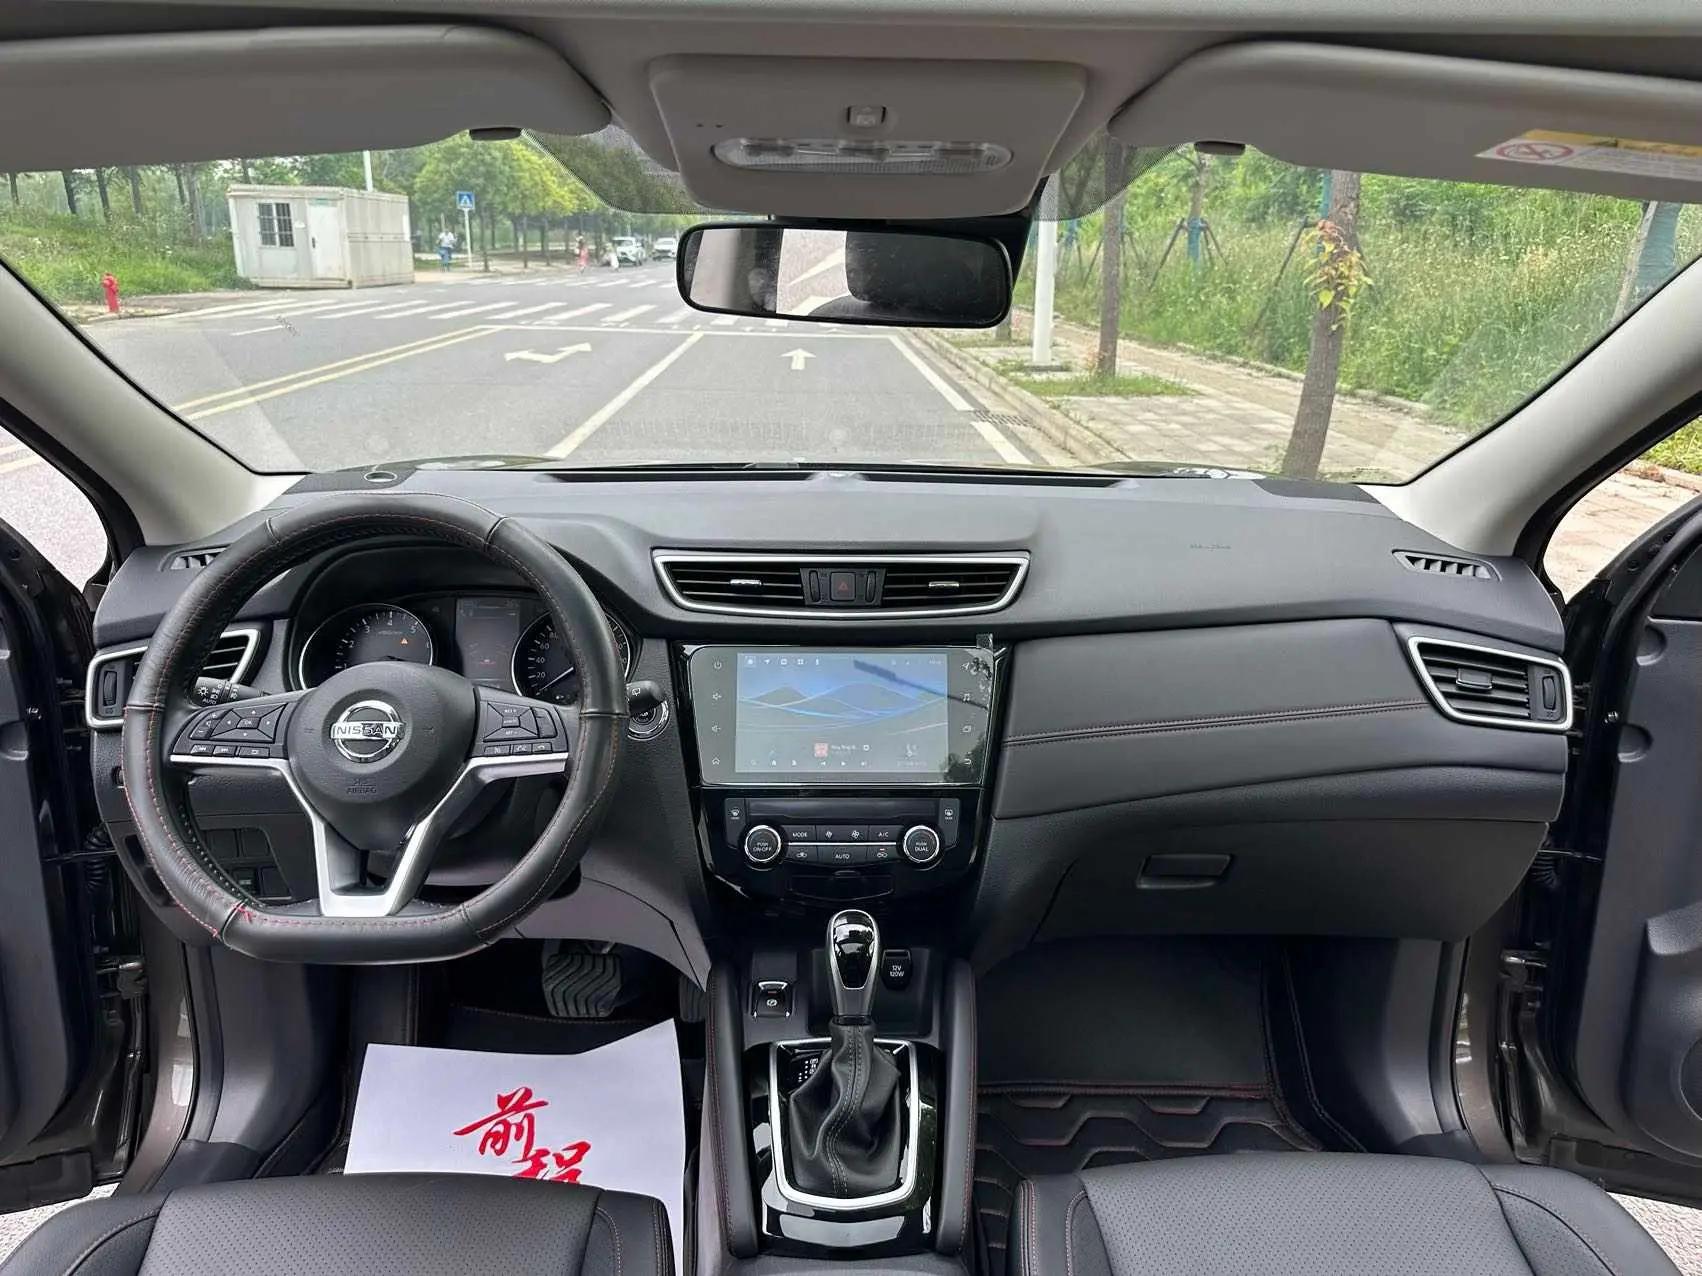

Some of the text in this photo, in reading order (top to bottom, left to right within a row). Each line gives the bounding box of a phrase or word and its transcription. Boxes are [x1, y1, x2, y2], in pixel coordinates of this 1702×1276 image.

[365, 625, 371, 634] 3
[349, 640, 355, 648] 2
[536, 671, 546, 679] 20
[336, 725, 398, 736] NISSAN
